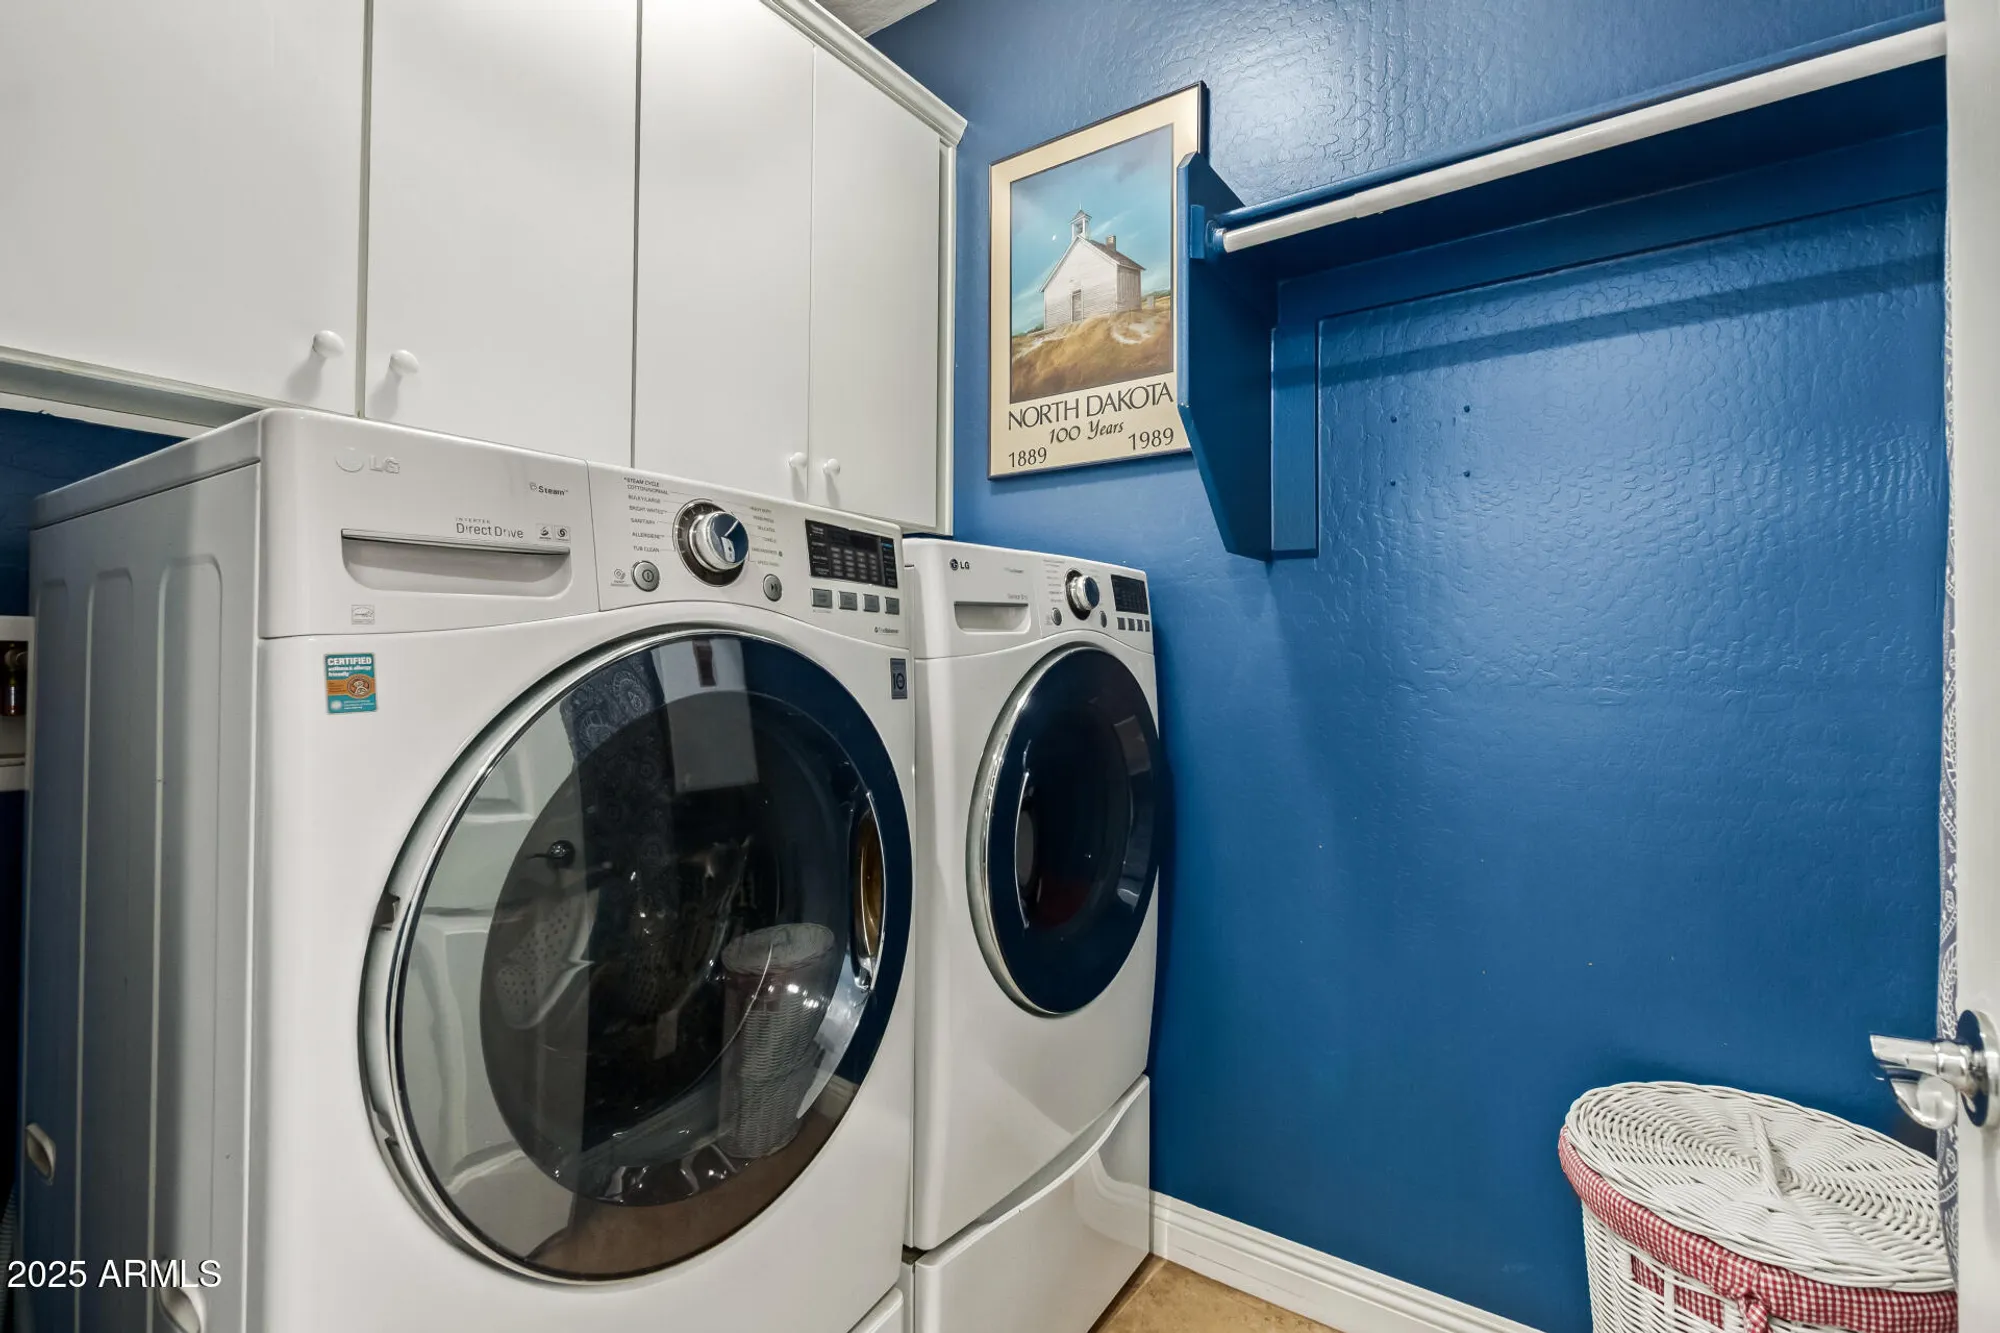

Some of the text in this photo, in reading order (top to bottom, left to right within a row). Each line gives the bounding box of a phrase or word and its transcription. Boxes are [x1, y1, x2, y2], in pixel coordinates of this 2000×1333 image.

[1008, 381, 1174, 431] NORTH DAKOTA
[1049, 418, 1125, 444] 100 Years
[1128, 427, 1174, 451] 1989
[368, 455, 400, 474] LG
[1008, 446, 1047, 468] 1889
[456, 522, 524, 539] Direct Drive
[959, 561, 970, 570] LG
[327, 656, 372, 666] CERTIFIED
